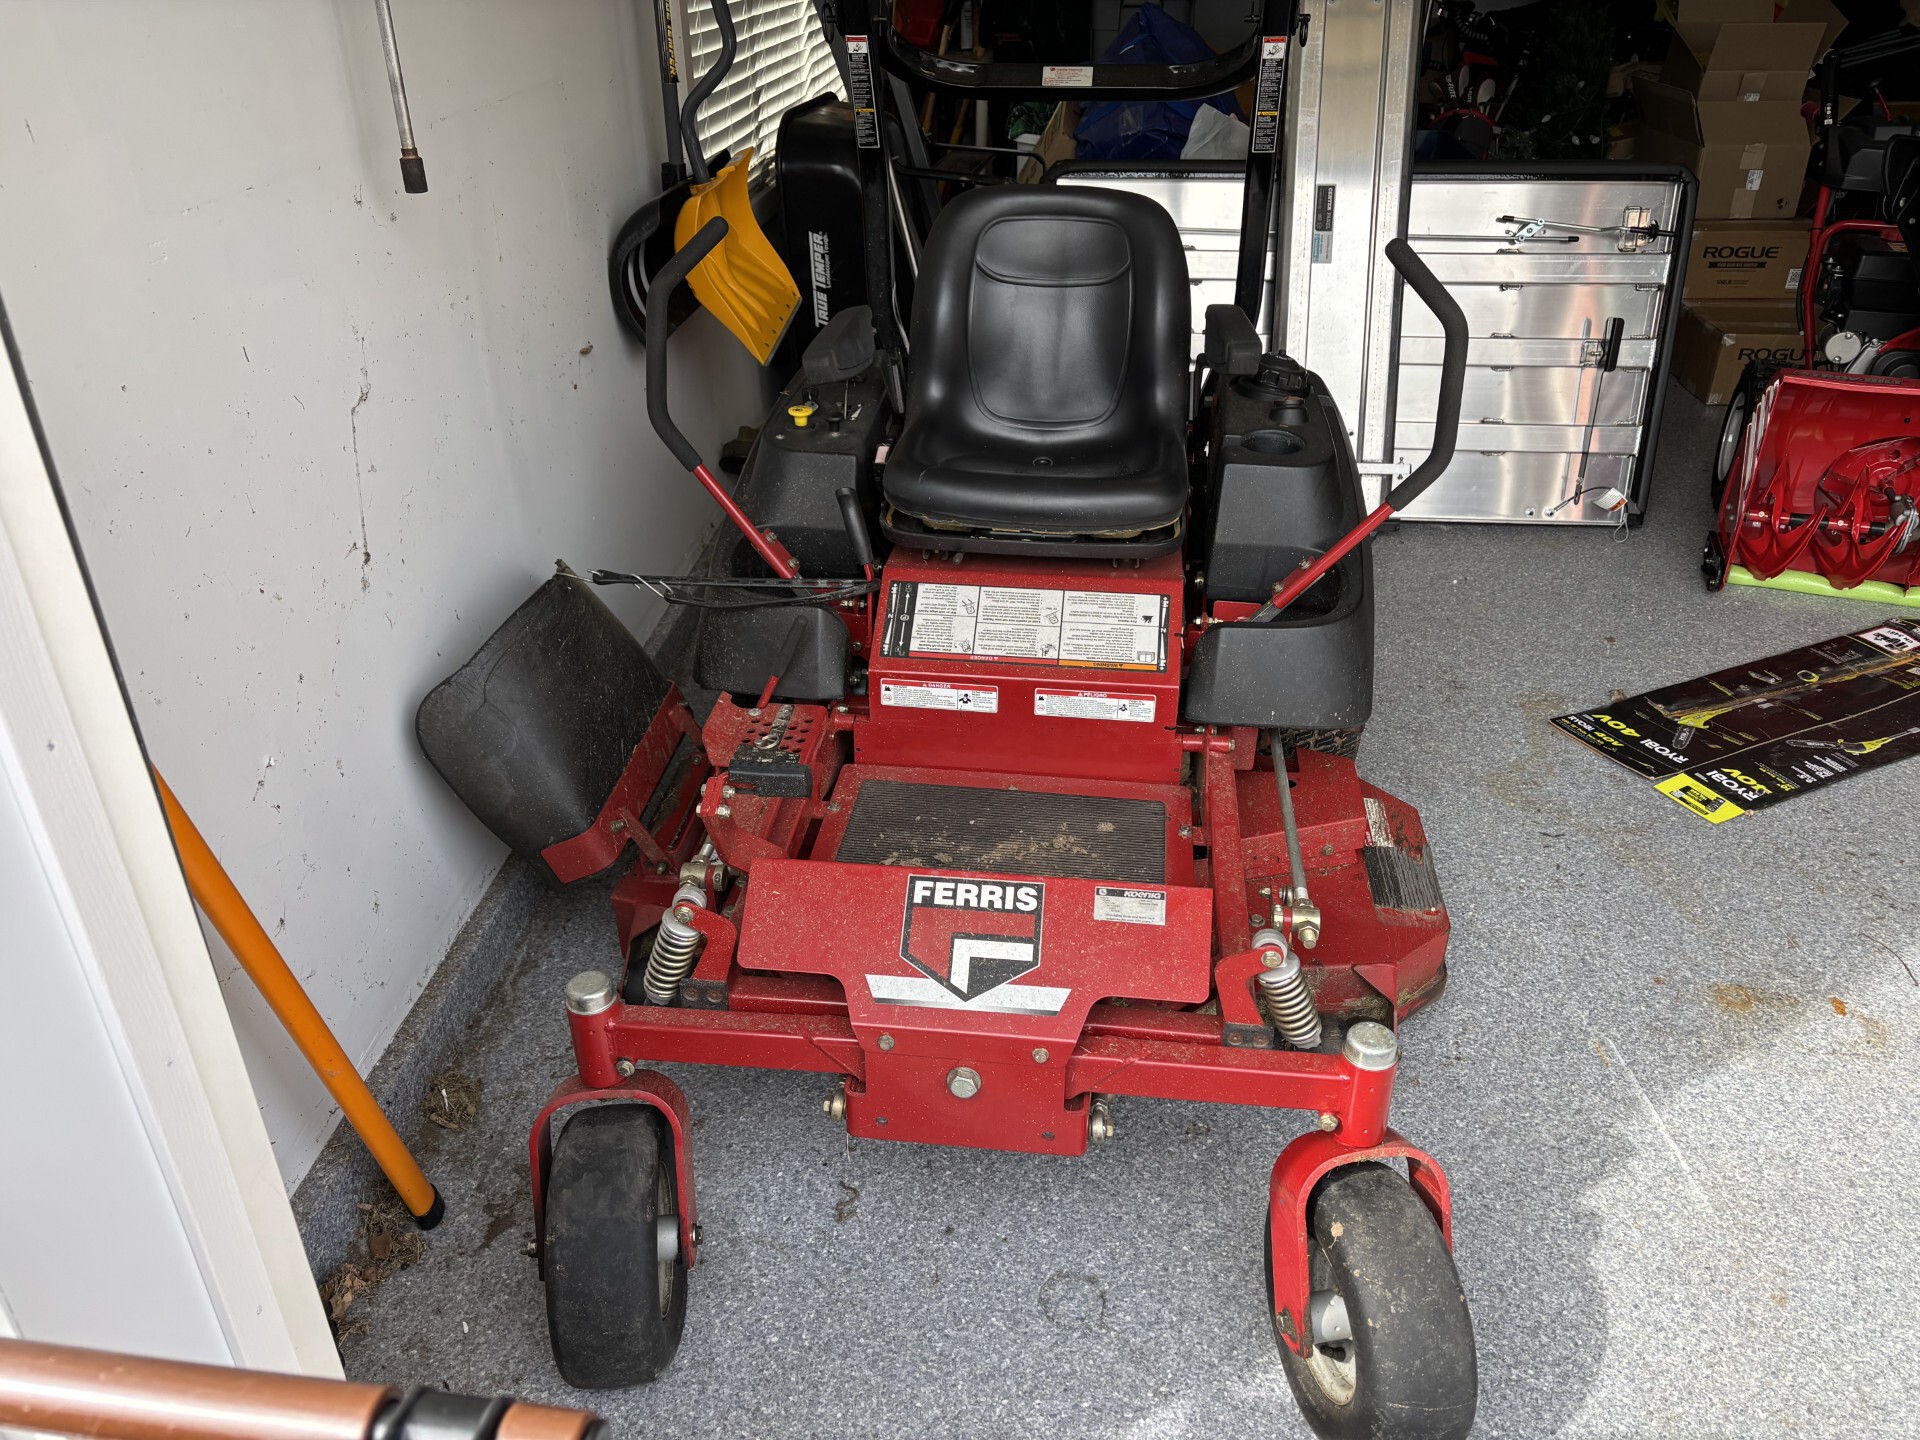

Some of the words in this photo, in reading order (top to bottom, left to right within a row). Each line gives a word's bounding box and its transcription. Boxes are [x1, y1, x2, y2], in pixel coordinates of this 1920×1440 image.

[808, 231, 827, 290] TEMPER
[1702, 246, 1783, 259] ROGUE
[813, 290, 829, 328] TRUE
[1591, 714, 1642, 738] 40V
[1594, 731, 1625, 747] 40V
[1640, 739, 1690, 764] RYOBI
[1706, 770, 1760, 801] RYOBI
[913, 880, 1038, 912] FERRIS
